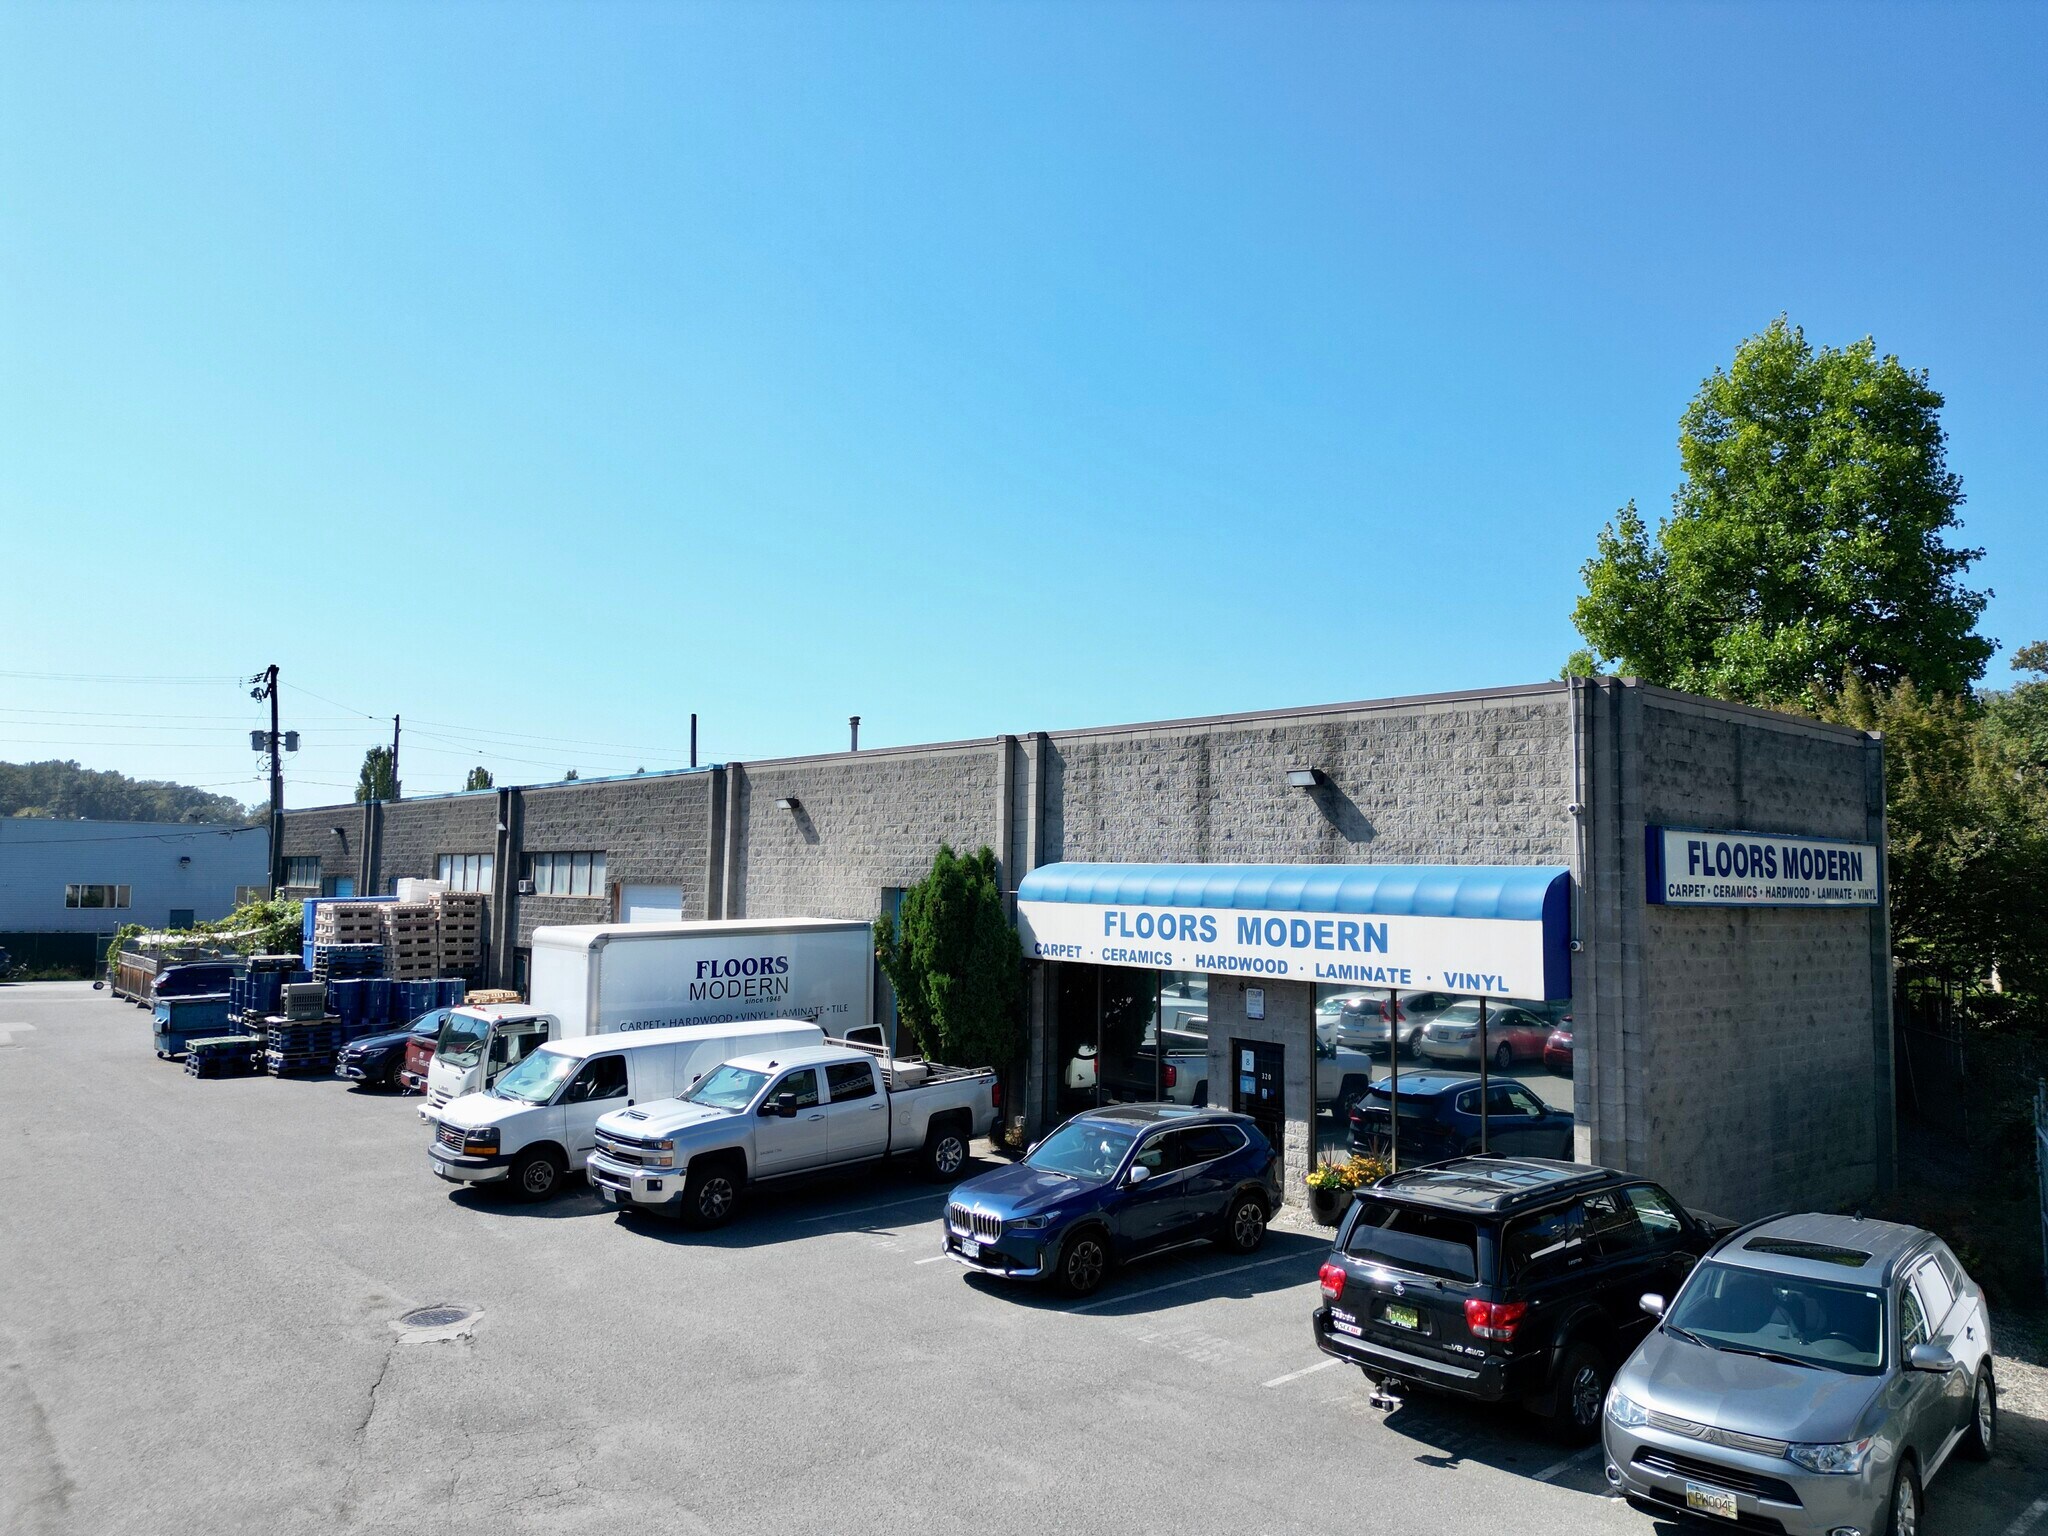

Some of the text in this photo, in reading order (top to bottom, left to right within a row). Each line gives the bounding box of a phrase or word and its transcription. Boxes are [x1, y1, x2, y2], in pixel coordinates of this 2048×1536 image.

[1688, 841, 1863, 882] FLOORS MODERN
[1668, 884, 1877, 900] CARPET CERAMICS HARDWOOD LAMINATE VINYL
[1104, 911, 1388, 954] FLOORS MODERN
[696, 956, 789, 979] FLOORS
[1034, 942, 1510, 992] CARPET CERAMICS HARDWOOD LAMINATE VINYL
[690, 976, 789, 1001] MODERN
[745, 995, 781, 1005] since 1948
[620, 1004, 849, 1032] CARPET HARDWOOD VINYL LAMINATE TILE
